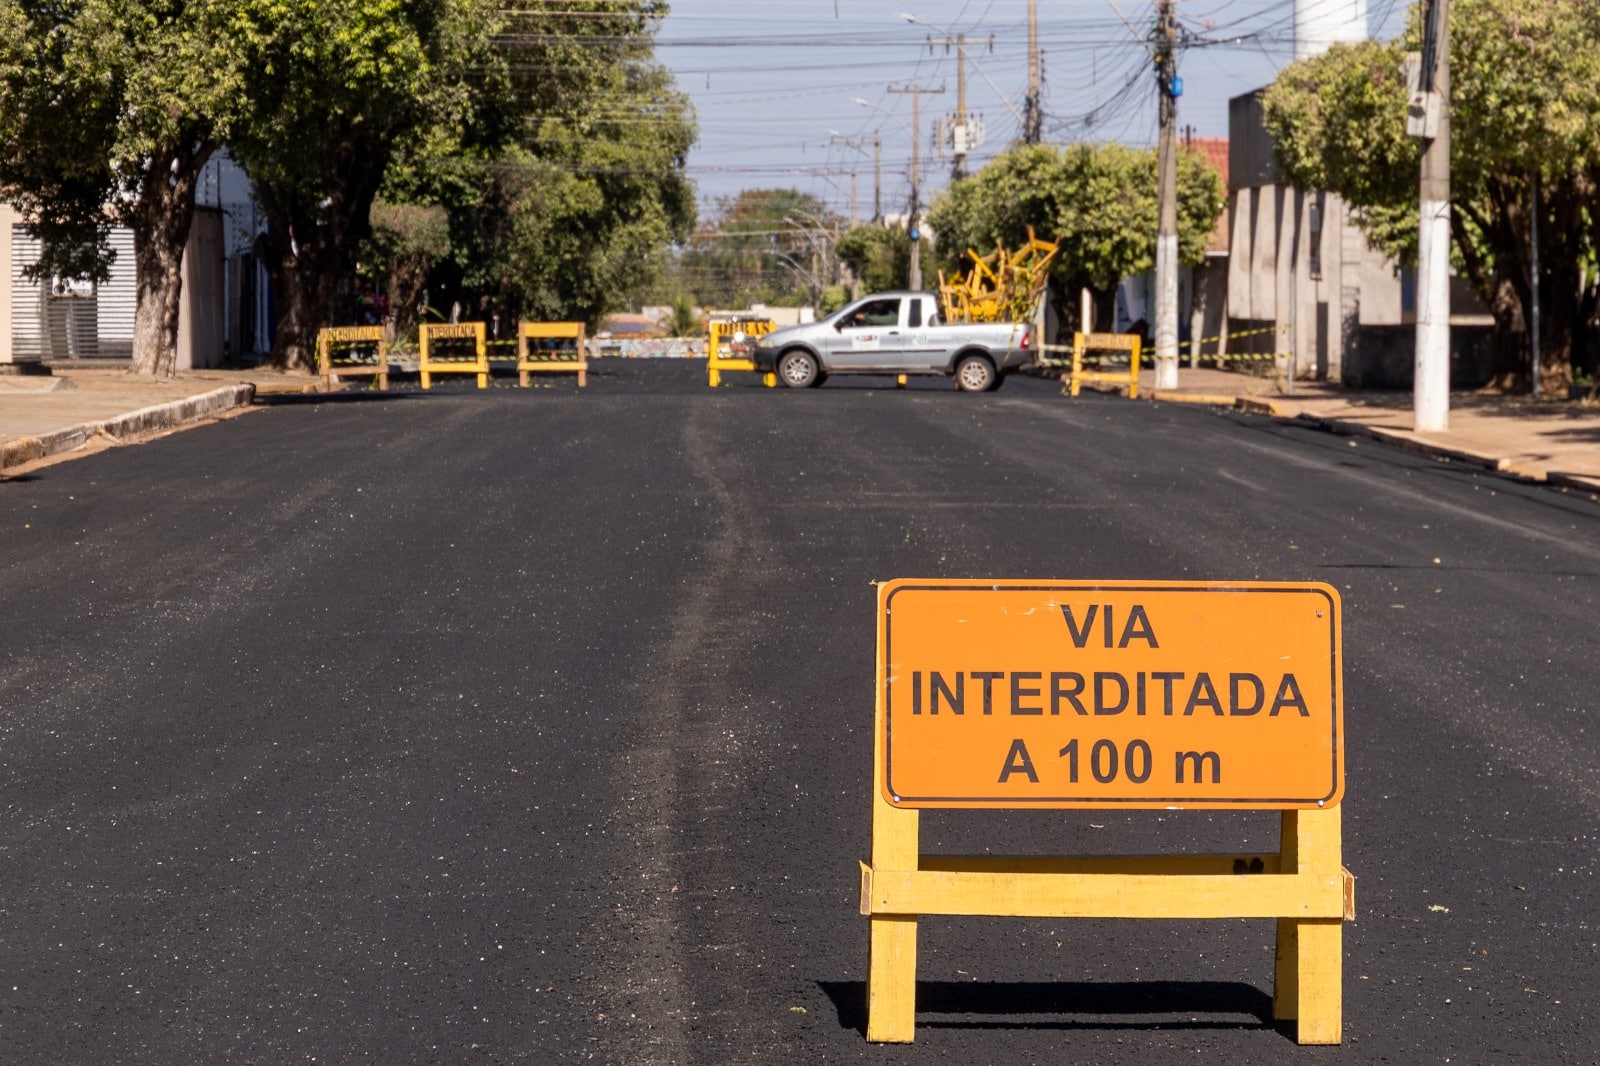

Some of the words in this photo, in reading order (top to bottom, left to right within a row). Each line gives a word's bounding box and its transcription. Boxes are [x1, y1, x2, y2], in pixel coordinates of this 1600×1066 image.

[1060, 604, 1159, 649] VIA
[911, 671, 1311, 717] INTERDITADA
[997, 739, 1039, 783] A
[1059, 739, 1153, 784] 100
[1175, 749, 1221, 784] m
